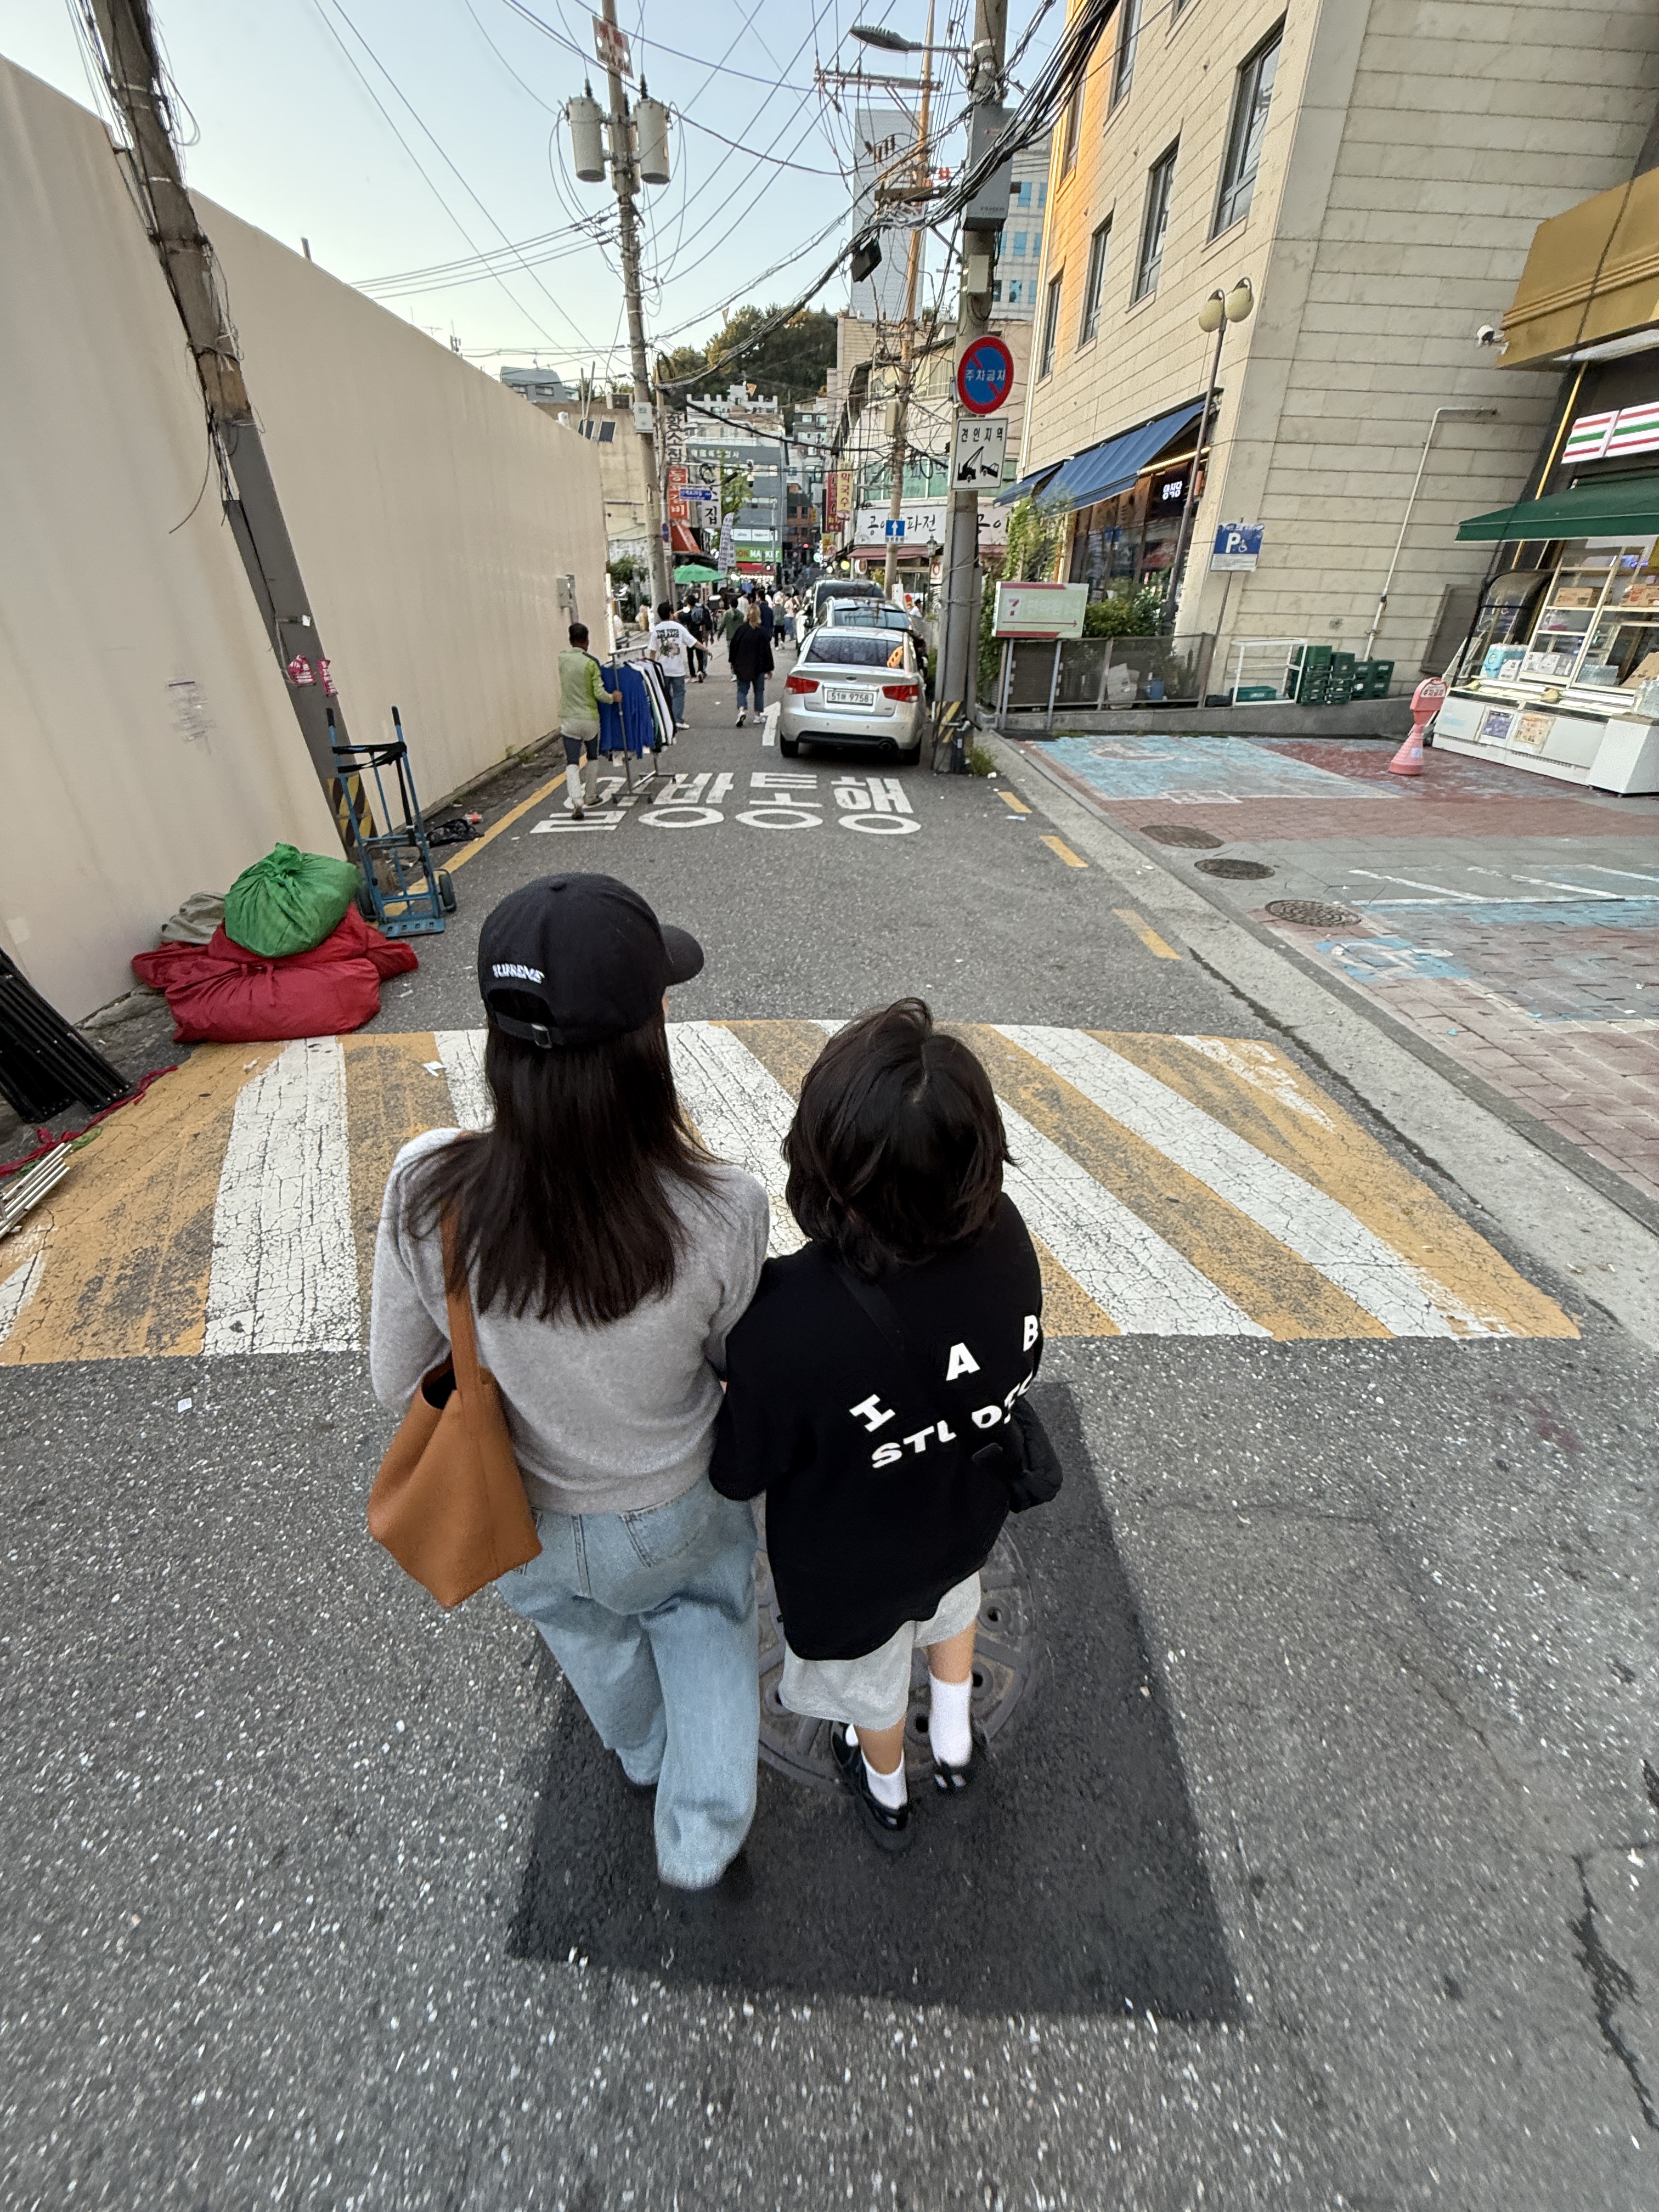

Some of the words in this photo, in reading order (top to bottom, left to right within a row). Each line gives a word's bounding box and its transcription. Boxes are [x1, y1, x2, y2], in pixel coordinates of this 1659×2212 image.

[961, 427, 1003, 443] 견인지역
[1225, 532, 1242, 554] P
[849, 693, 869, 702] 9758
